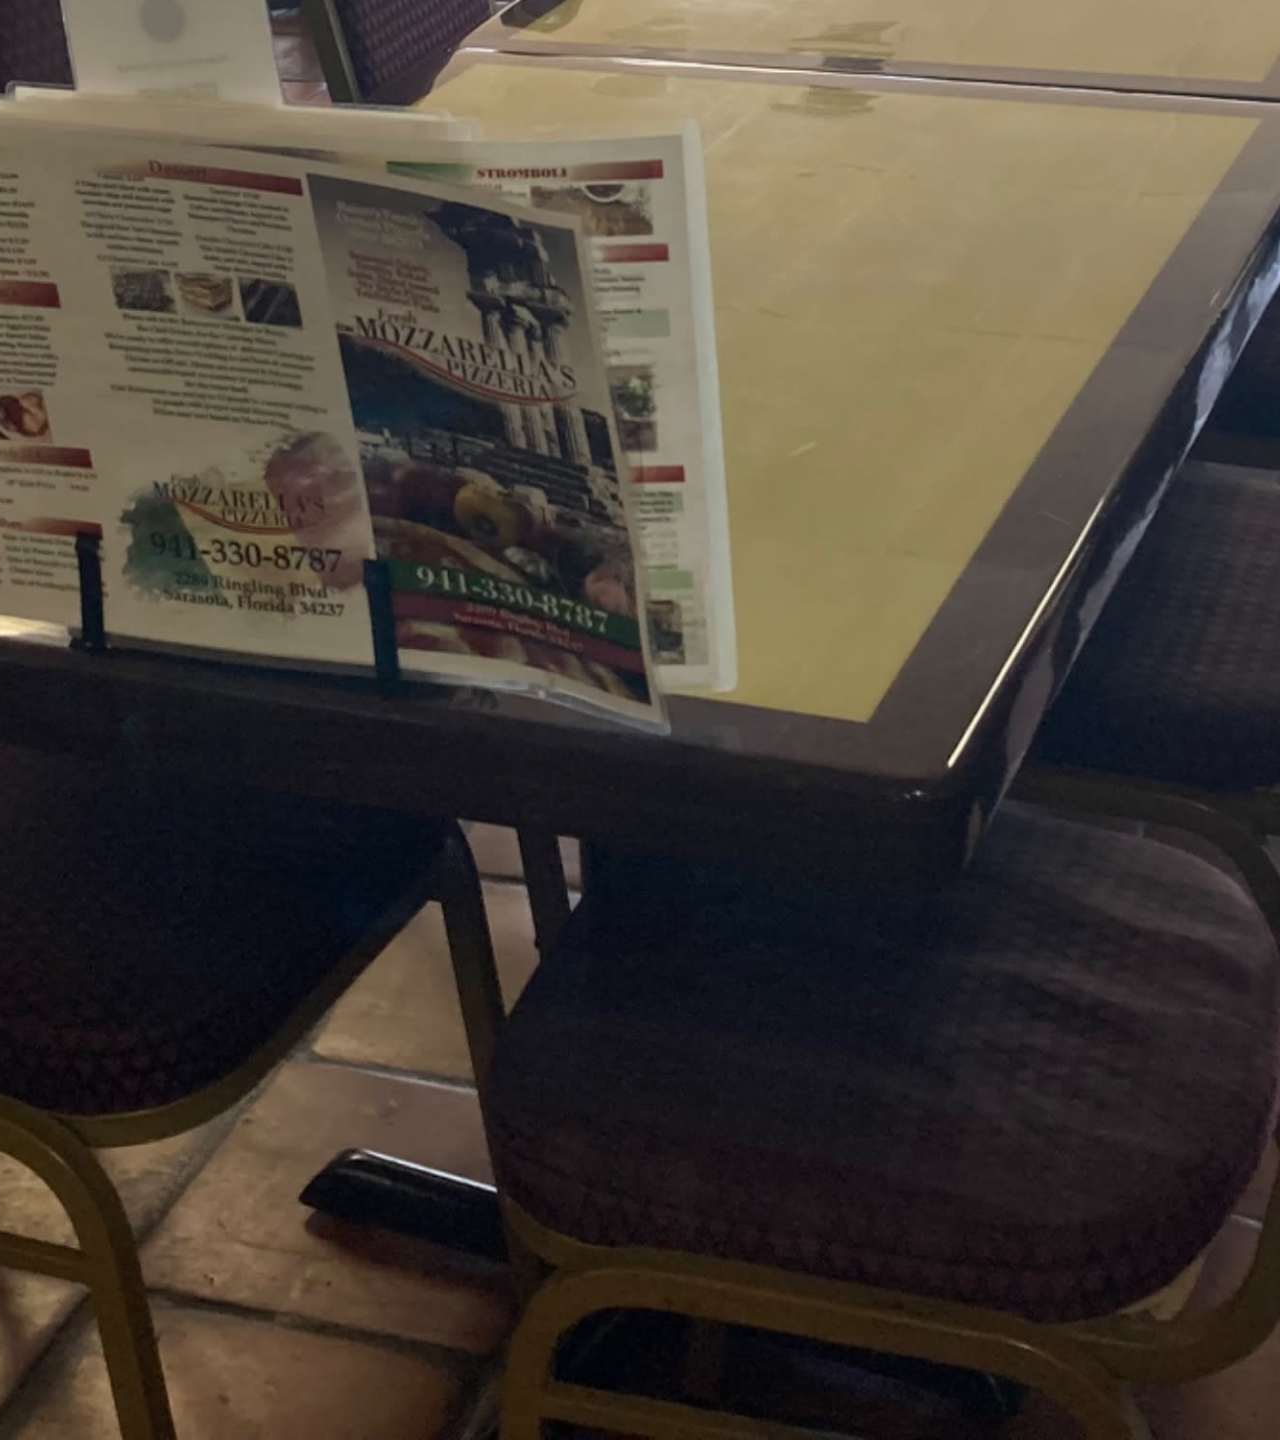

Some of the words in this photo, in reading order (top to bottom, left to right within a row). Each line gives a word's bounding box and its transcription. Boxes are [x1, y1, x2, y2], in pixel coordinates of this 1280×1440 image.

[476, 166, 569, 180] STROMBOLI
[354, 315, 577, 390] MOZZARELLA'S
[446, 358, 552, 401] PIZZERIA
[150, 532, 343, 574] 941-330-8787
[211, 574, 287, 597] Ringling
[289, 583, 328, 599] Blvd
[237, 594, 296, 615] Florida
[299, 601, 346, 617] 34237
[416, 565, 609, 633] 941-330-8787
